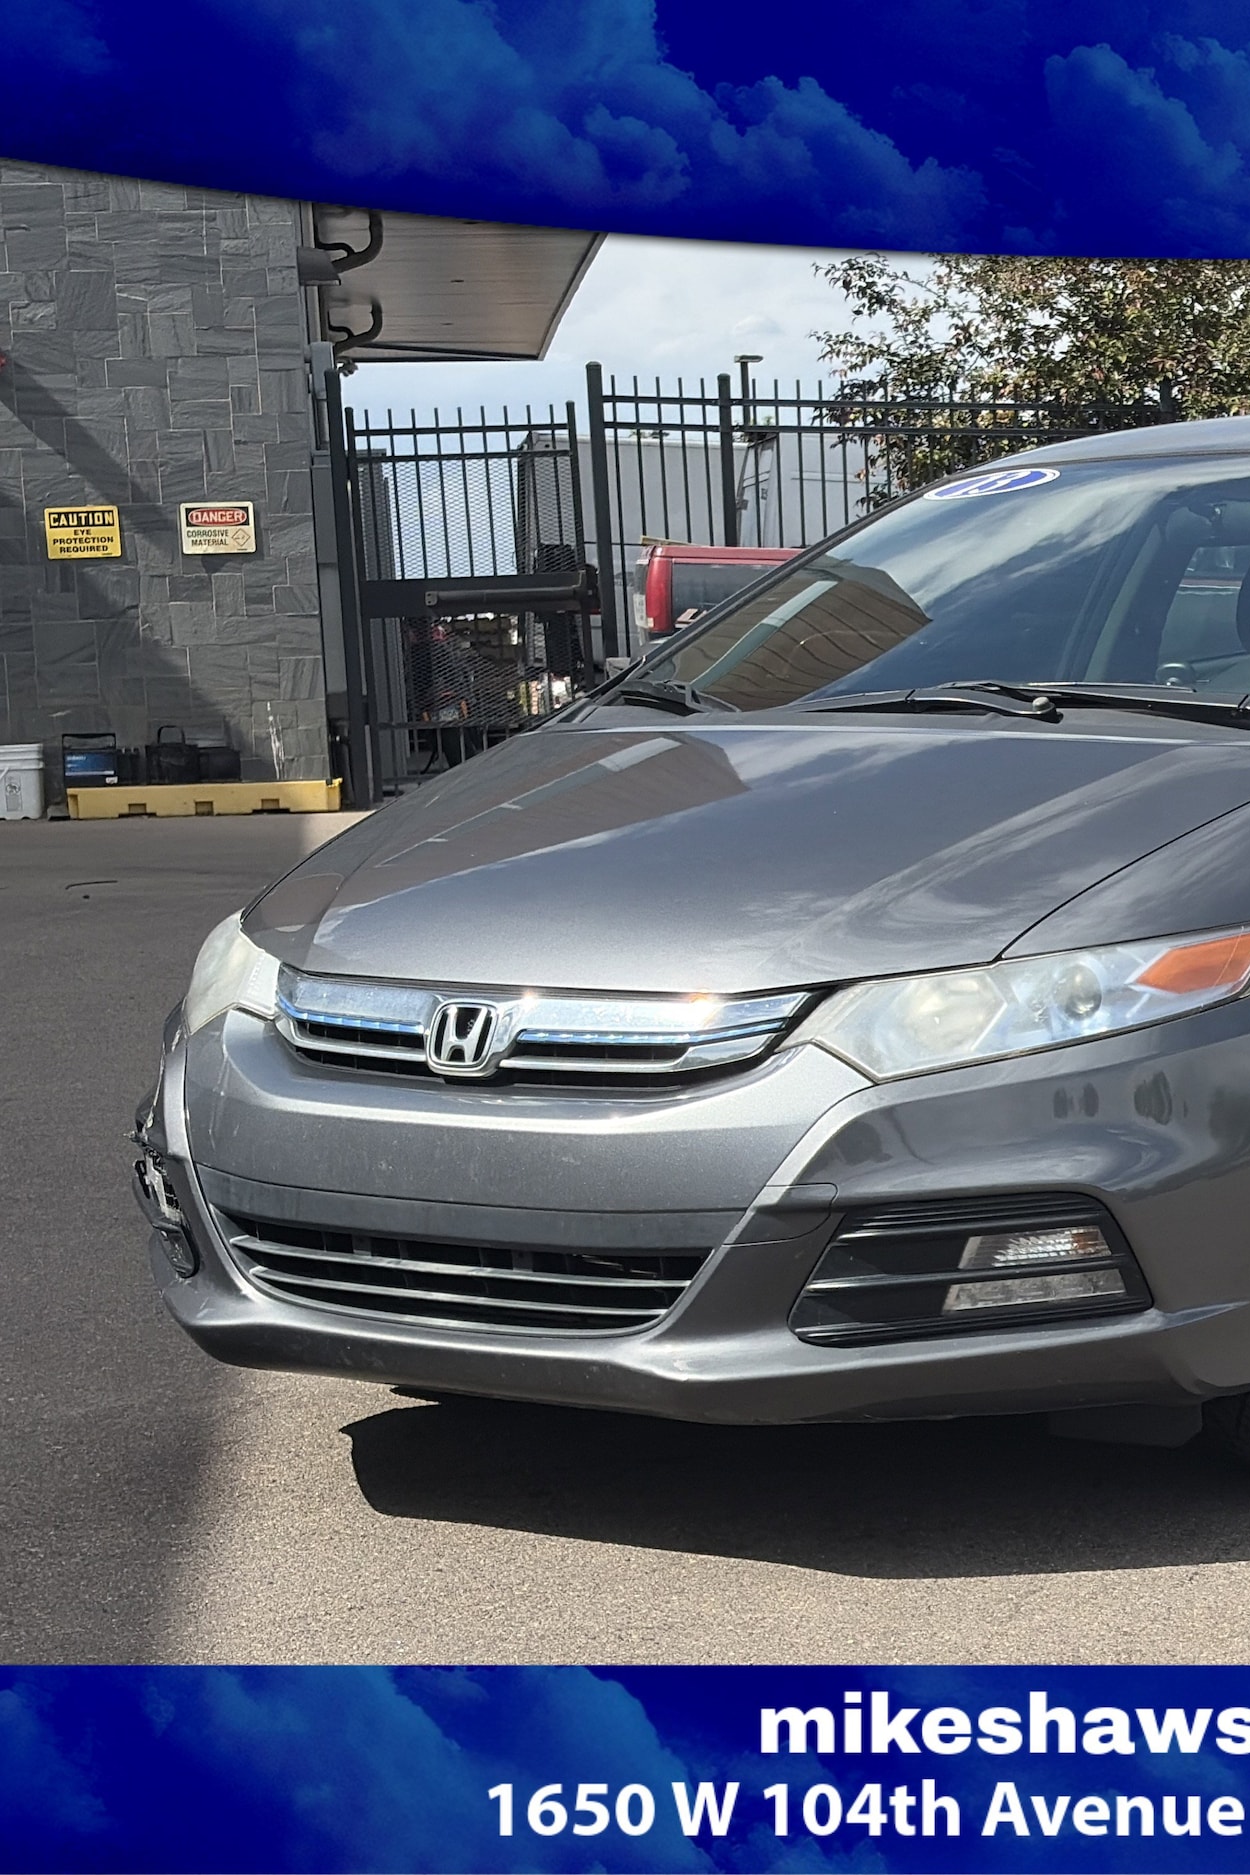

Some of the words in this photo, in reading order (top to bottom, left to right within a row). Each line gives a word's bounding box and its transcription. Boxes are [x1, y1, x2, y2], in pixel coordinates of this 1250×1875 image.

[49, 511, 114, 527] CAUTION
[192, 510, 243, 523] DANGER
[186, 529, 229, 539] CORROSIVE
[52, 536, 114, 546] PROTECTION
[191, 538, 229, 547] MATERIAL
[59, 545, 109, 554] REQUIRED
